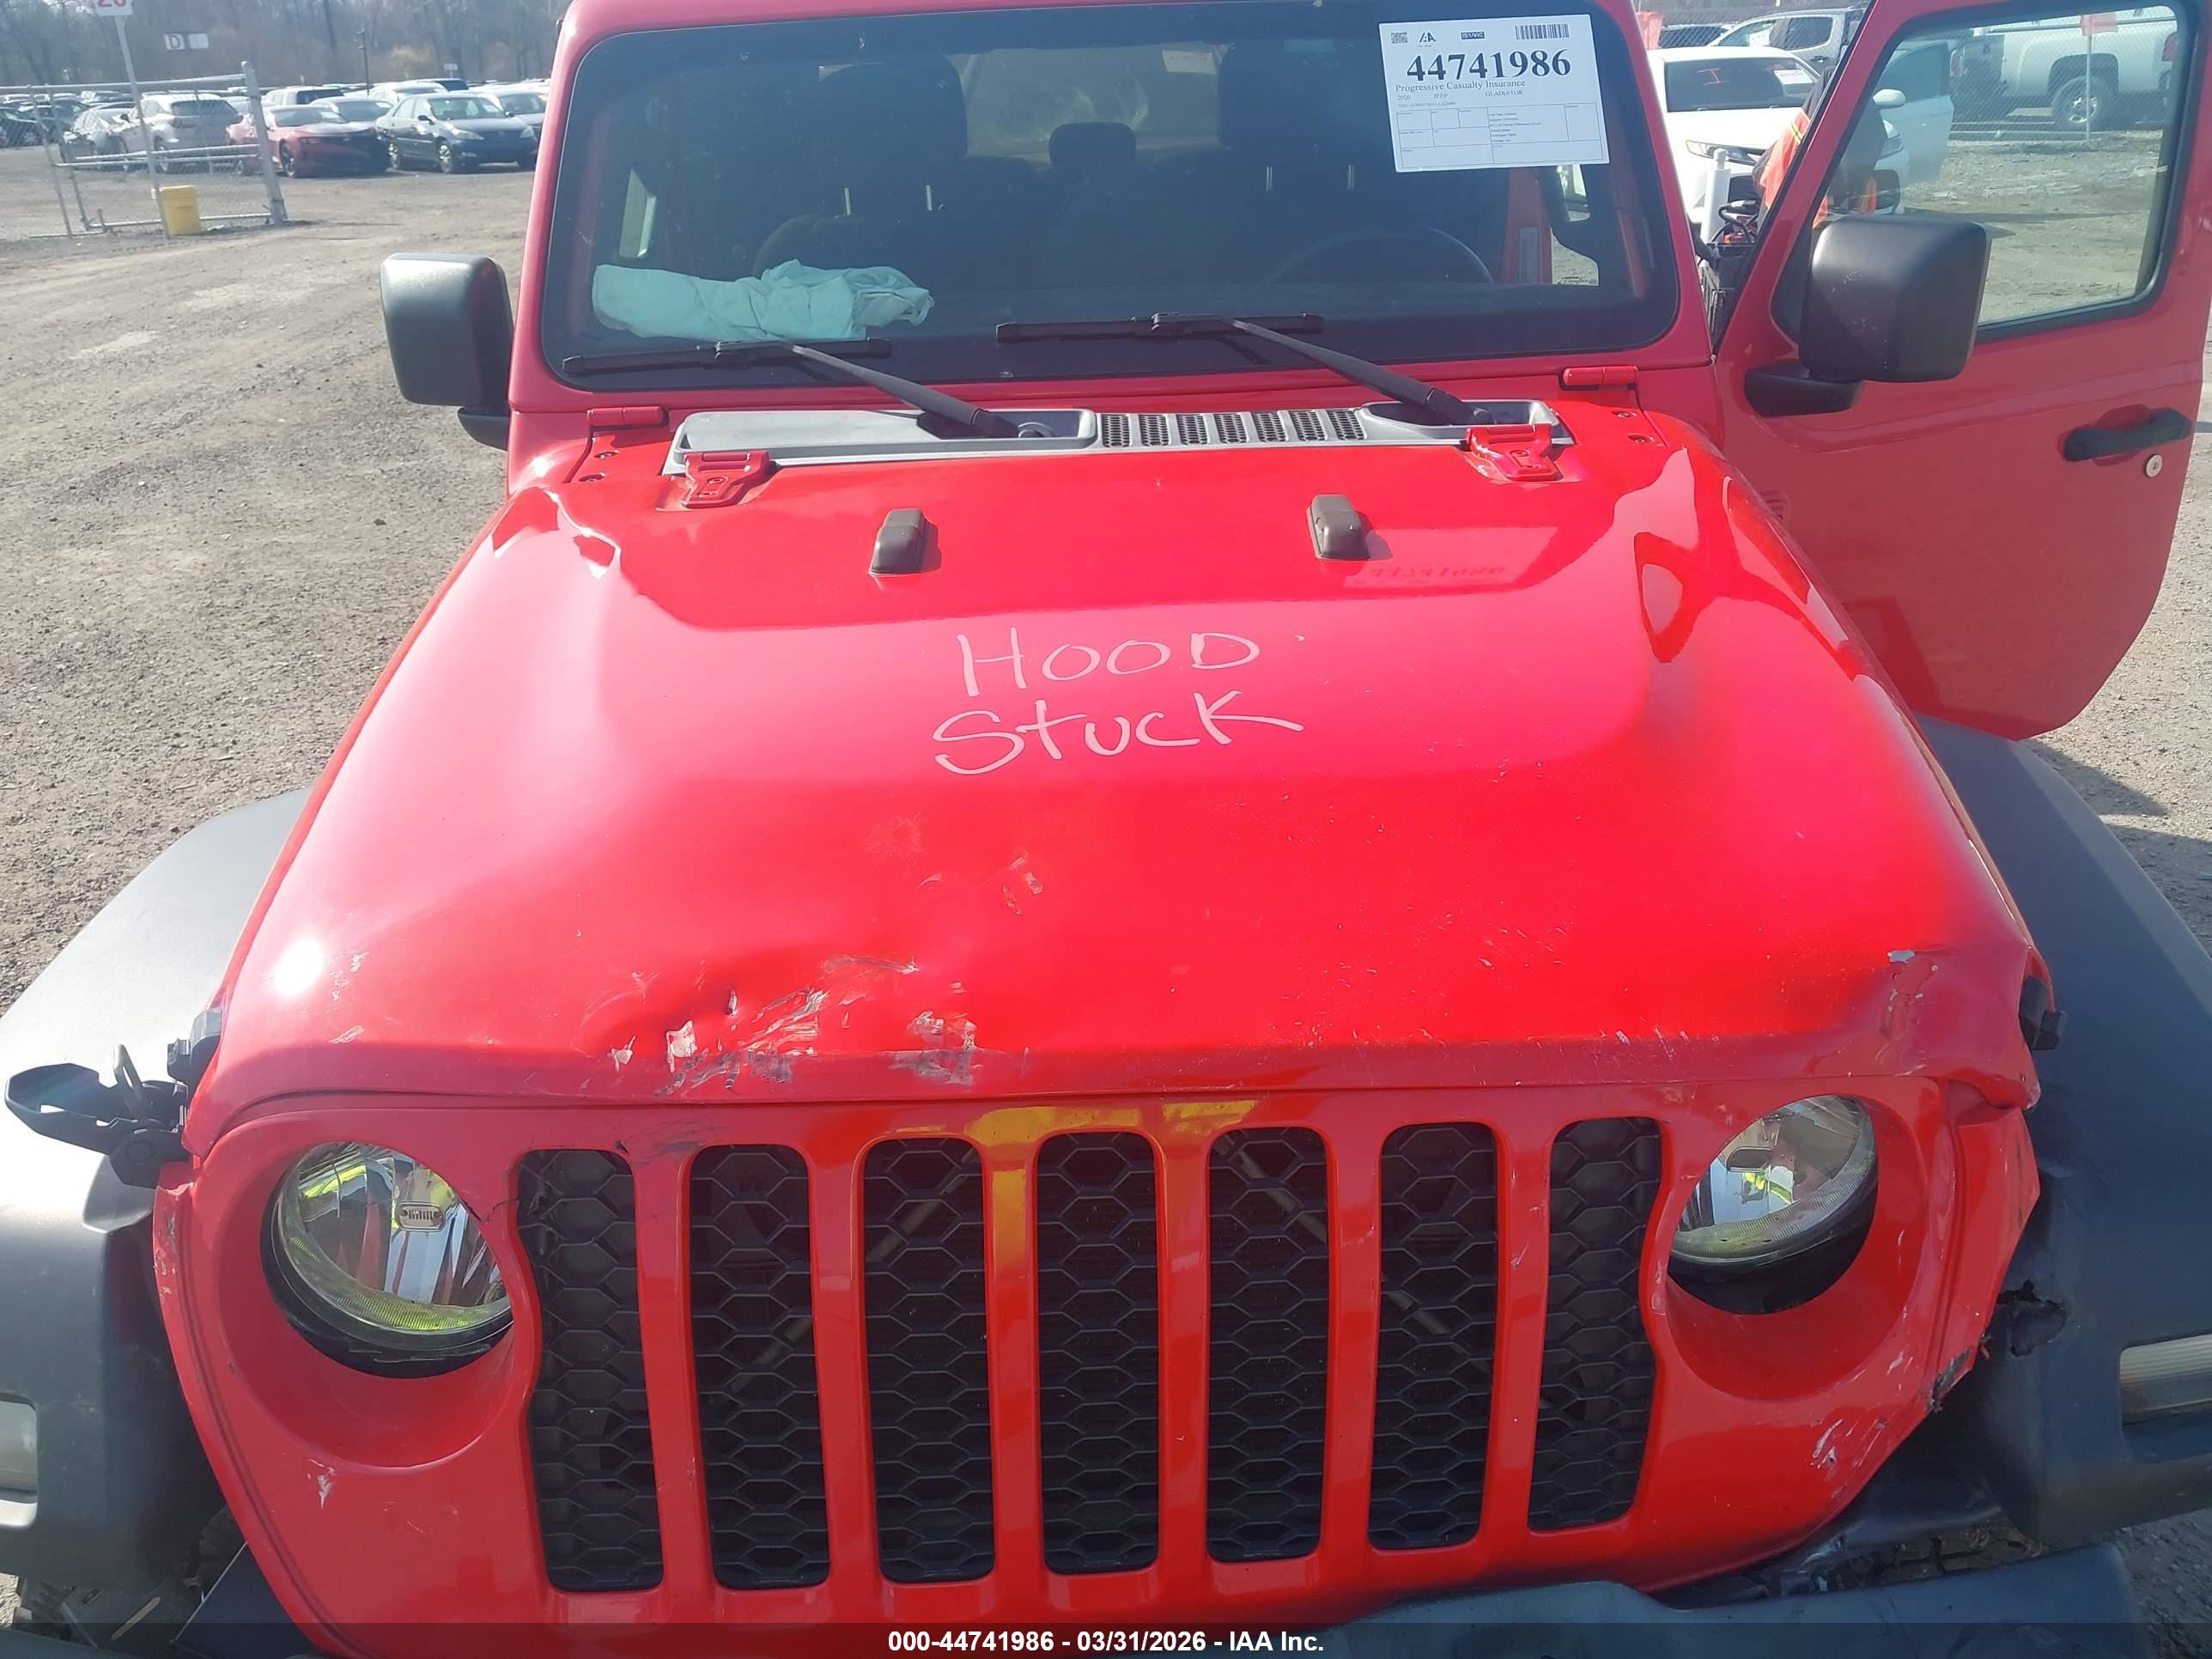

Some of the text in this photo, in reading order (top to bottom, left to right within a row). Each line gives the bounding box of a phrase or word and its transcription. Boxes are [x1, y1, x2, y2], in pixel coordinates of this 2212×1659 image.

[1407, 49, 1571, 82] 44741986
[1395, 82, 1444, 93] Progressive
[1446, 81, 1484, 90] Casualty
[957, 627, 1261, 696] HOOD
